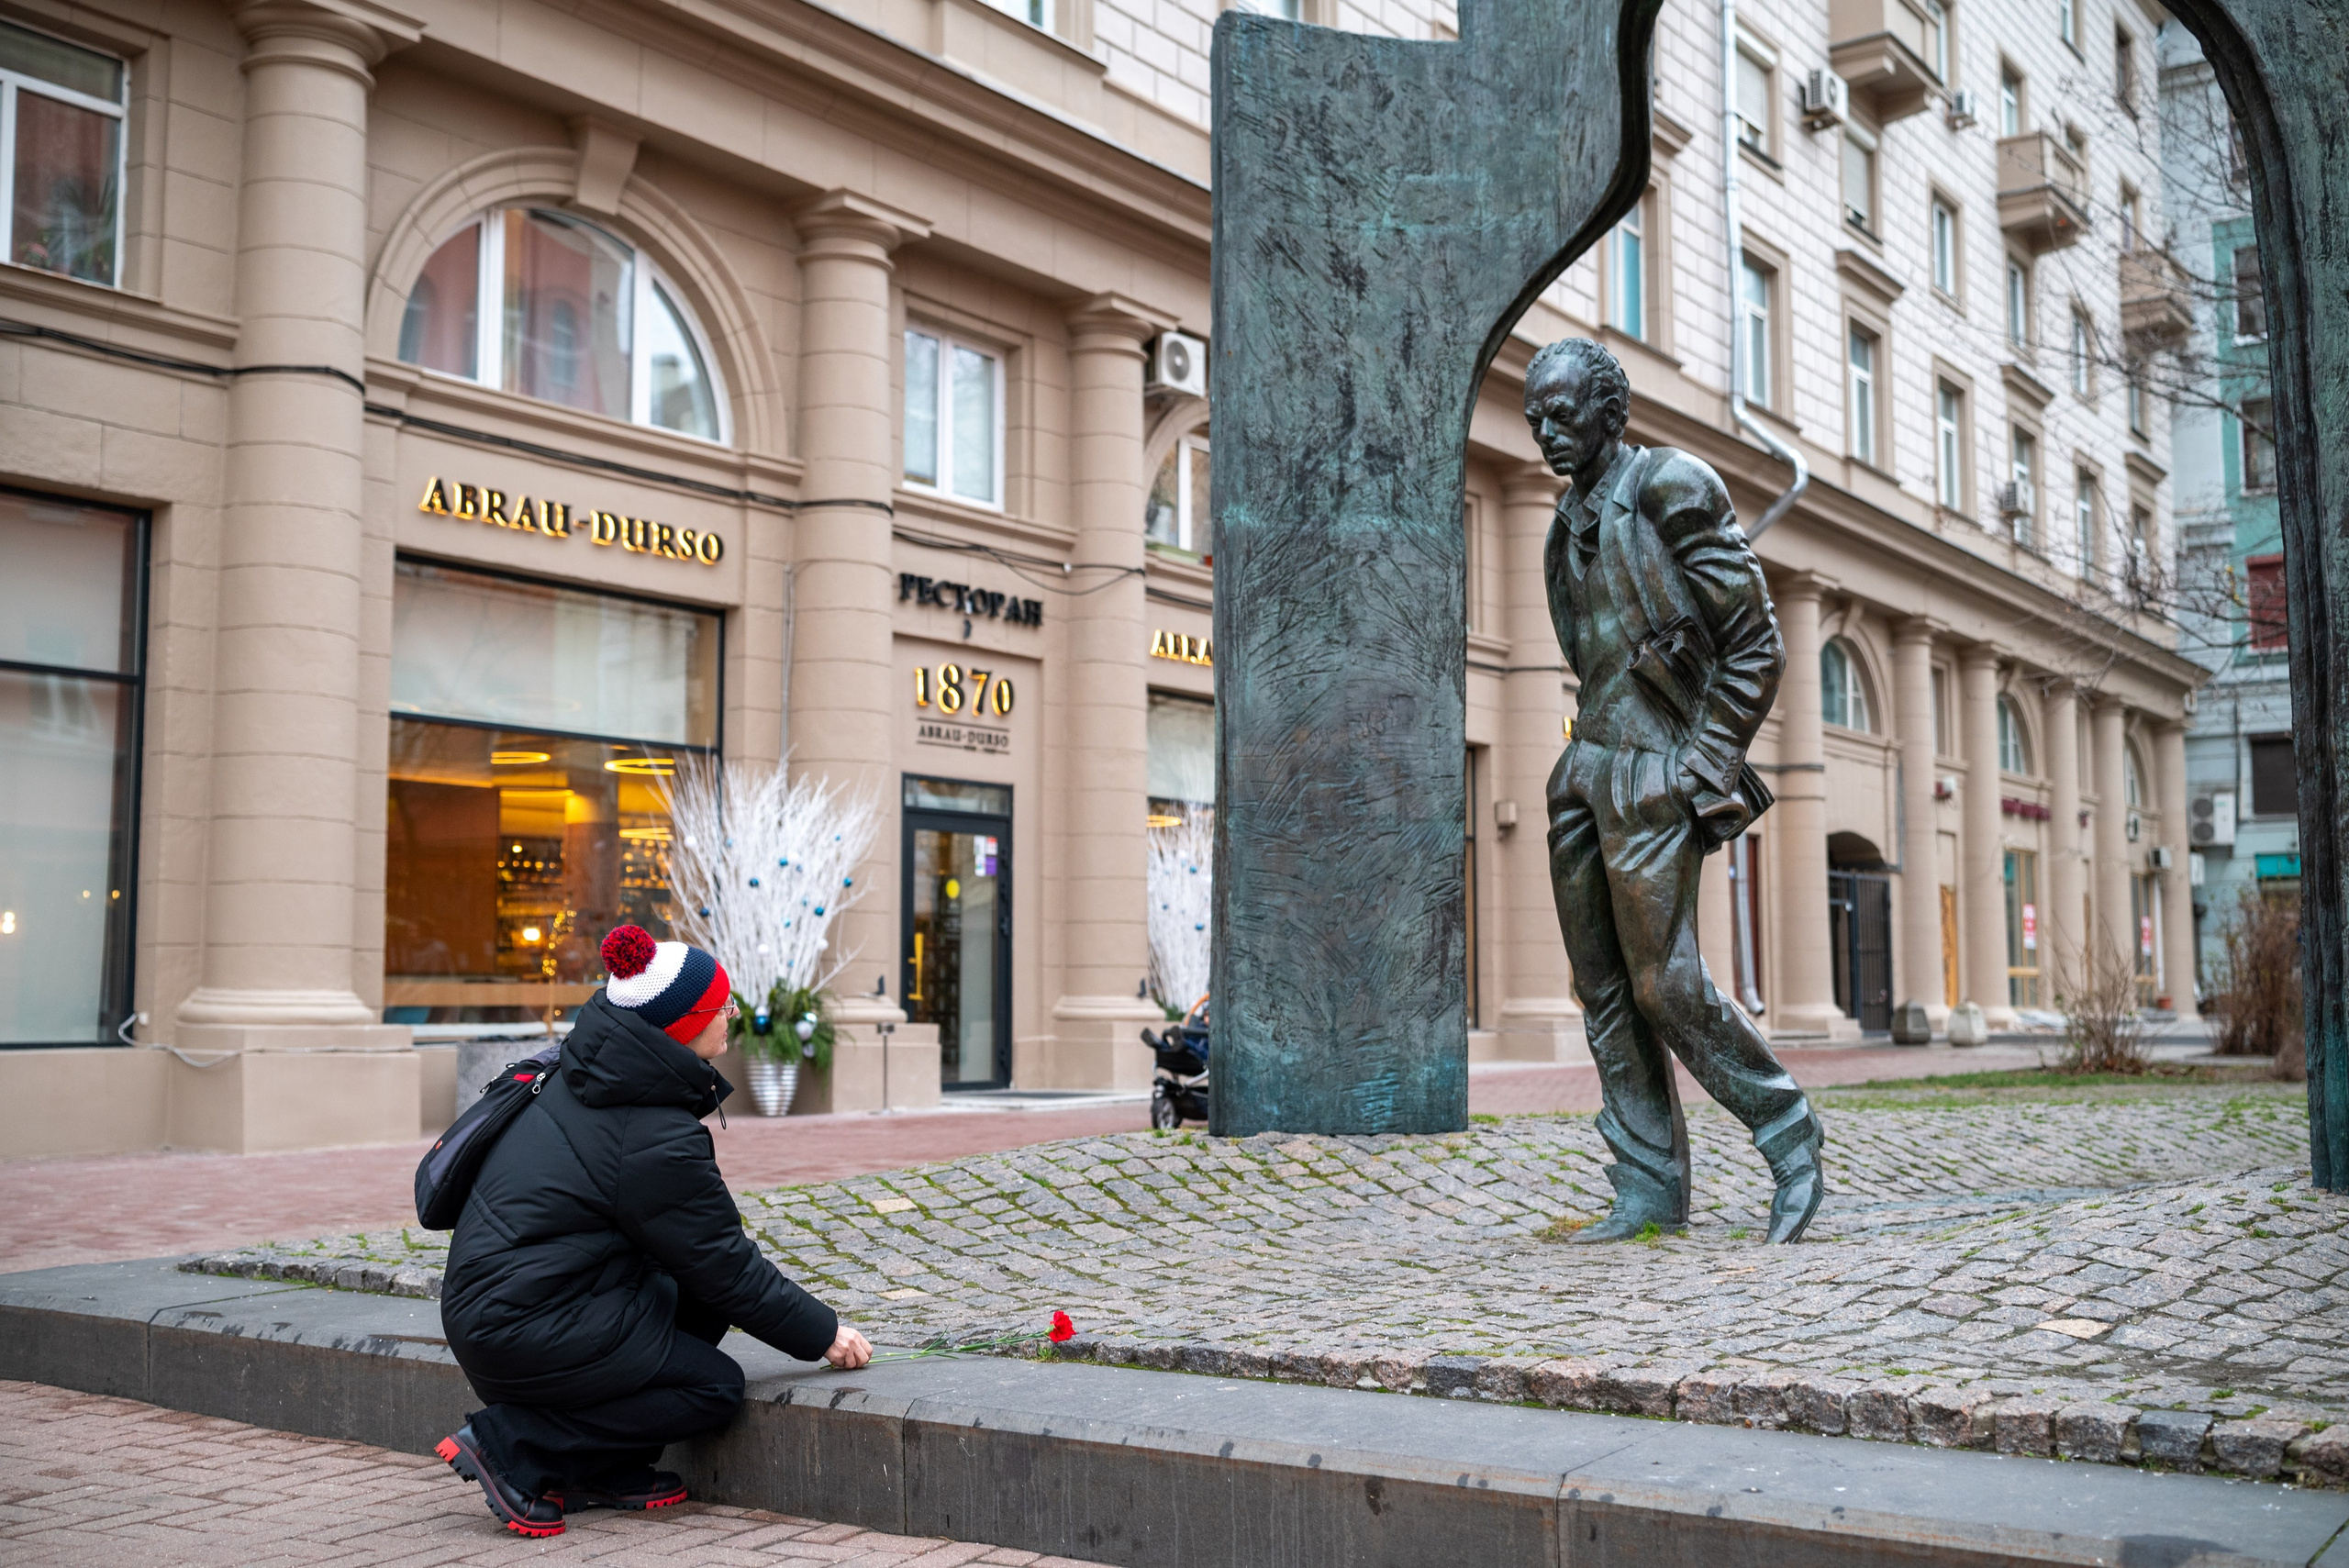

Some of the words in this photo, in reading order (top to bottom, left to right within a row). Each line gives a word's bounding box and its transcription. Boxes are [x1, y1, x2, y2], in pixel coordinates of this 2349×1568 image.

[418, 476, 725, 565] ABRAU-DURSO
[899, 573, 1042, 628] РЕСТОРАН
[1150, 629, 1212, 666] ABRA
[915, 663, 1014, 717] 1870
[918, 725, 1008, 748] ABRAU-DURSO
